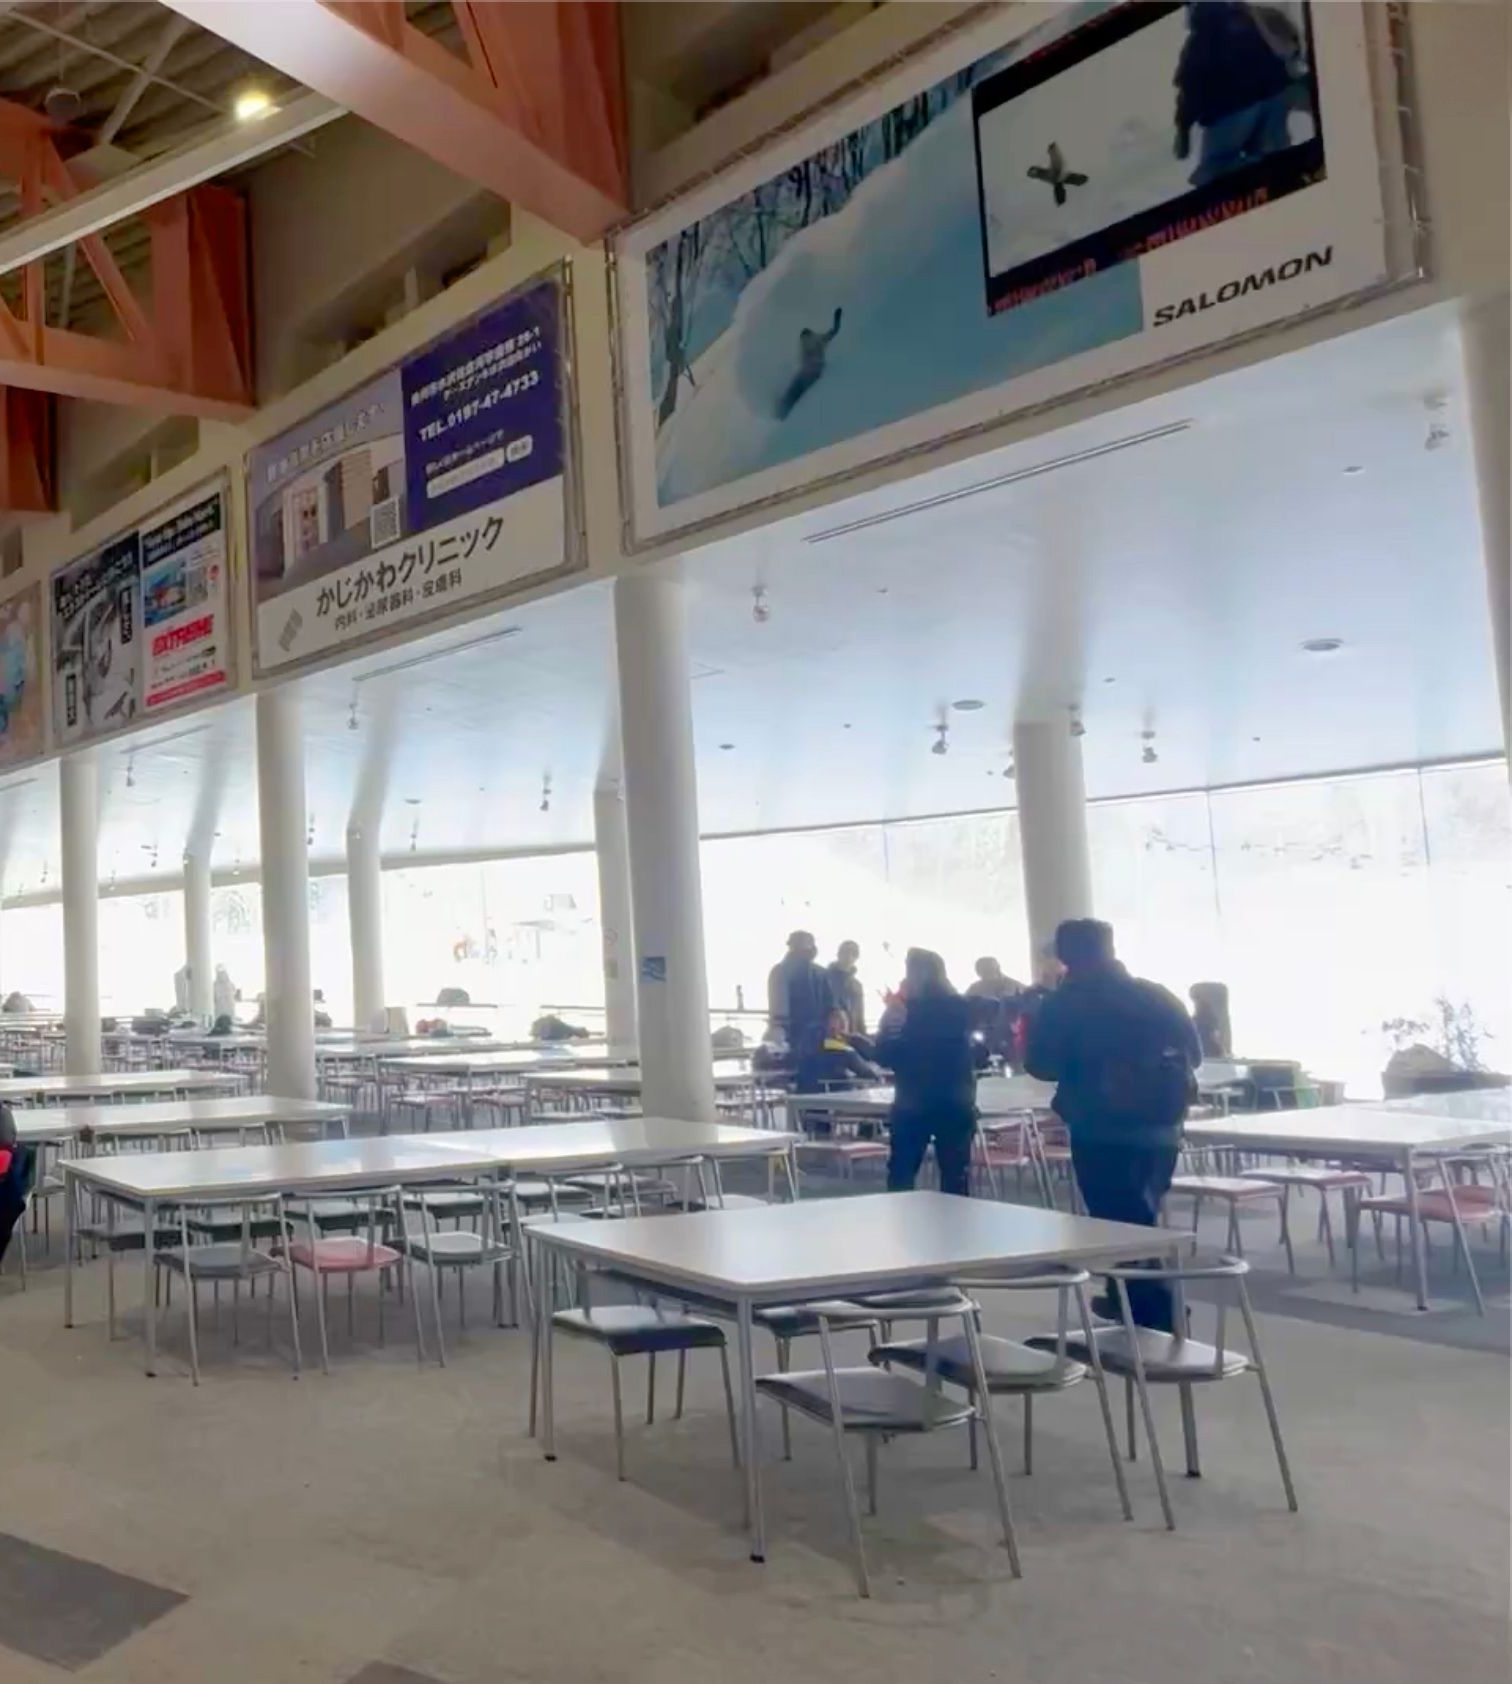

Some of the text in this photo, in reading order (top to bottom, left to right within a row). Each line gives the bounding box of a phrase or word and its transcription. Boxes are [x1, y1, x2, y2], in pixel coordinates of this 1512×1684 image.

[1152, 246, 1334, 328] SALOMON
[316, 515, 504, 618] かじかわクリニック
